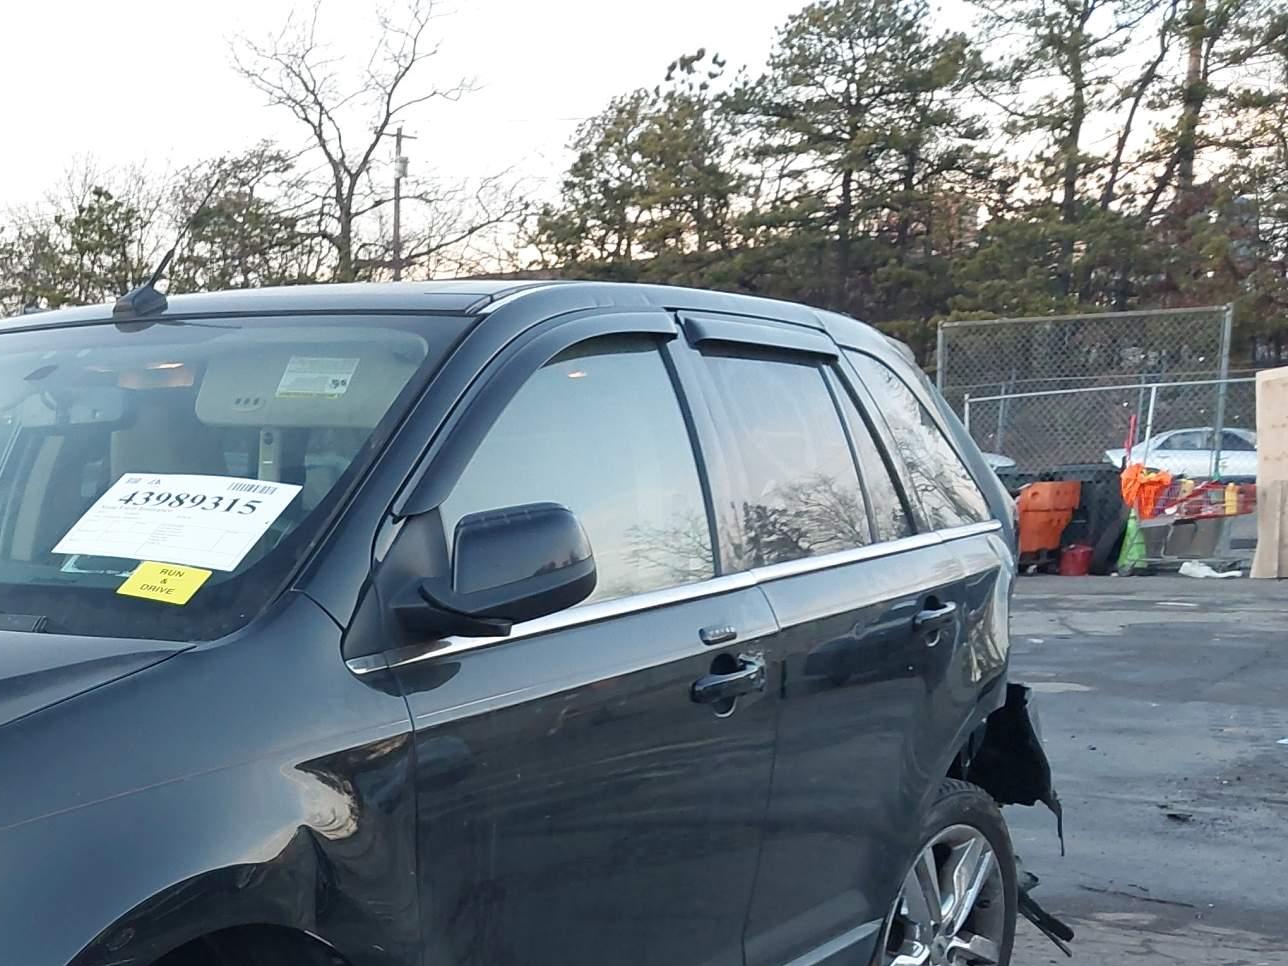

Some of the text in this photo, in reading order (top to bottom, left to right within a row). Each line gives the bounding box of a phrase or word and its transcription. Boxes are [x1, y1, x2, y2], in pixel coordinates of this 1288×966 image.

[119, 491, 263, 515] 43989315
[159, 568, 185, 578] RUN
[139, 583, 175, 595] DRIVE
